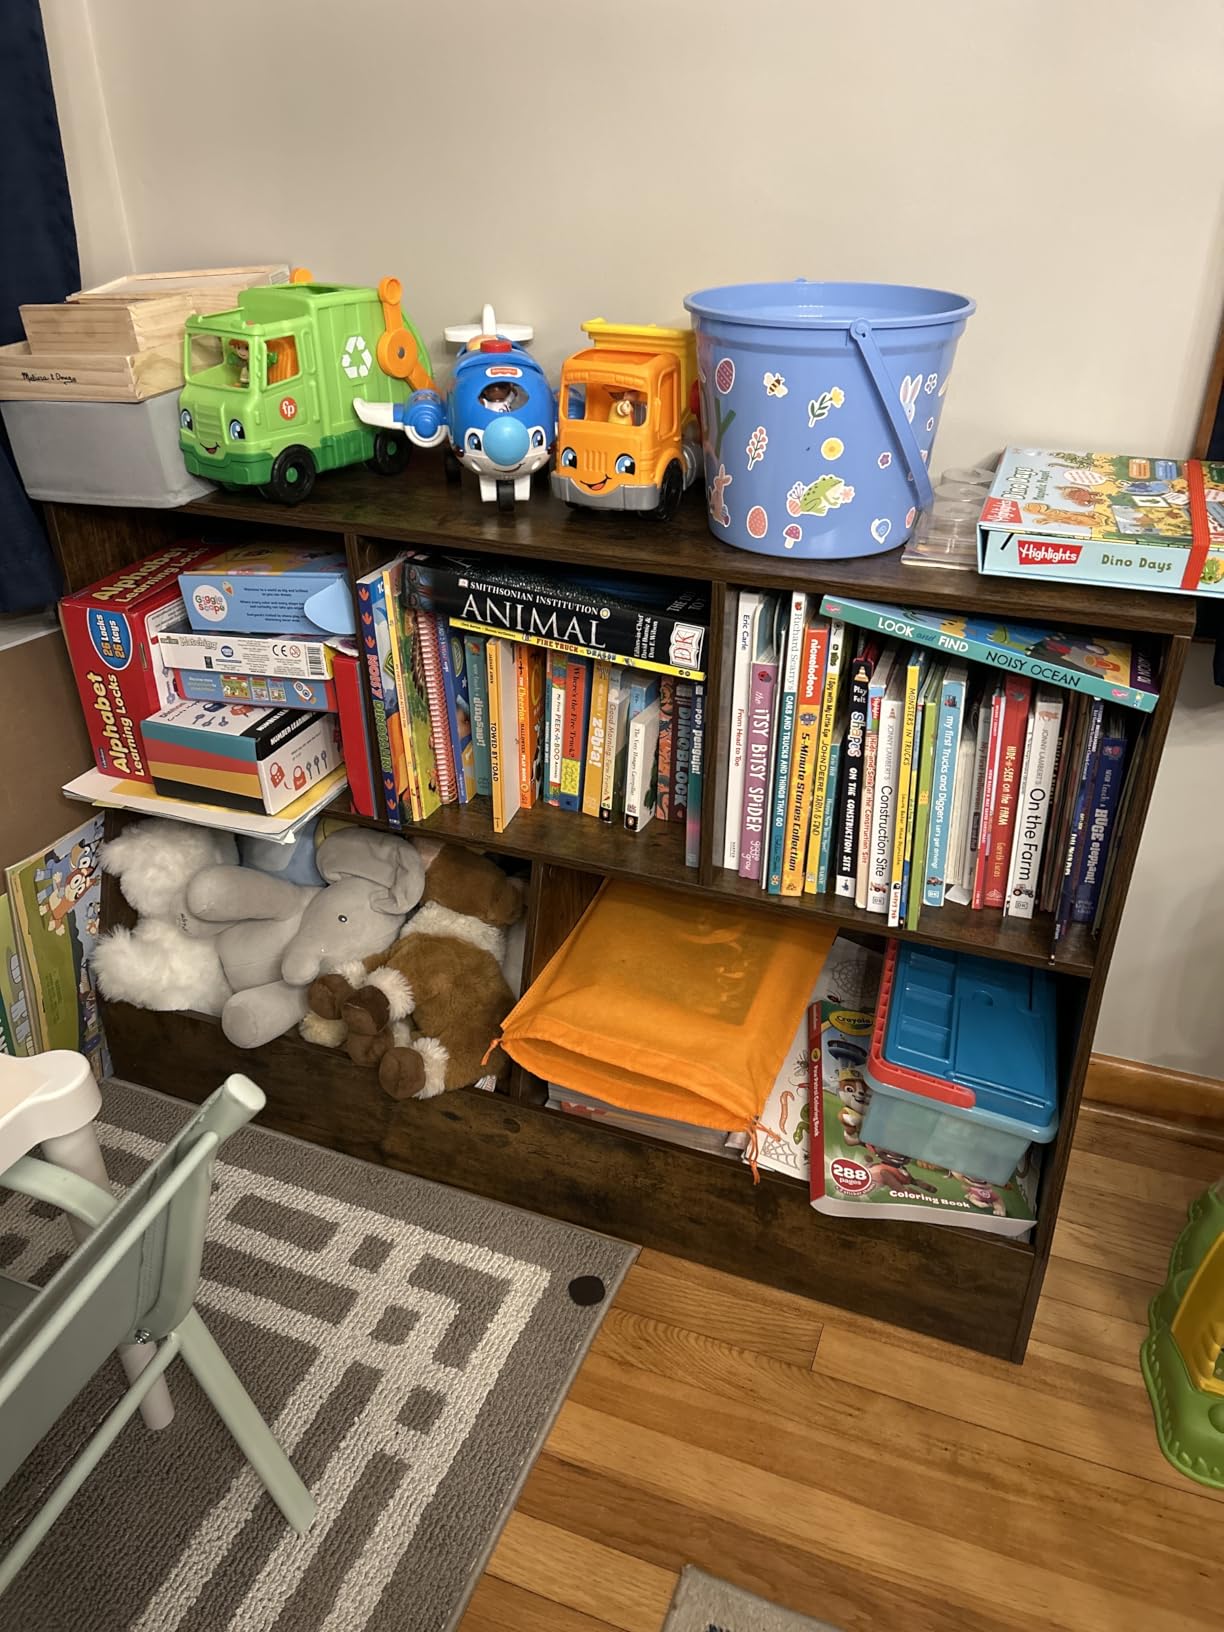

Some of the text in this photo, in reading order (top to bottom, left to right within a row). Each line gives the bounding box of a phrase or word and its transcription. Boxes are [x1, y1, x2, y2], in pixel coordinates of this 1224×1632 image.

[283, 401, 296, 416] fp
[1019, 544, 1078, 562] Highlights
[1102, 554, 1172, 572] Dino Days
[92, 548, 188, 600] Alphabet
[116, 566, 179, 602] Learning
[198, 604, 225, 614] Scope
[470, 581, 598, 616] SMITHSONIAN INSTITUTION
[96, 614, 112, 657] 26 Locks
[460, 593, 606, 648] ANIMAL
[110, 620, 126, 658] 26 Keys
[536, 637, 617, 661] FIRE TRUCK DRAGON
[672, 631, 696, 664] DK
[740, 630, 748, 650] Carle
[785, 612, 802, 690] Richard Scarry's
[878, 617, 1081, 688] LOOK and FIND NOISY OCEAN
[804, 638, 820, 698] nickelodeon
[753, 691, 764, 704] the
[825, 691, 833, 703] with
[826, 680, 834, 690] Spy
[854, 686, 868, 696] Play
[365, 652, 395, 774] NOISY DINOSAURS
[516, 686, 526, 720] Cheerios
[566, 666, 582, 758] Where's the Fire Truck?
[736, 708, 744, 727] From
[784, 695, 793, 714] CARS
[825, 704, 832, 713] My
[905, 687, 915, 726] MONSTERS
[86, 672, 130, 774] Alphabet
[108, 674, 144, 776] Learning Locks
[471, 695, 488, 746] dinosaur!
[783, 715, 791, 730] AND
[824, 713, 832, 727] Little
[904, 728, 912, 737] IN
[489, 722, 499, 781] TOWED BY TOAD
[552, 713, 561, 760] PEEK-A-BOO
[588, 716, 605, 767] zebra!
[690, 729, 702, 774] penguin!
[780, 731, 790, 759] TRUCKS
[819, 739, 827, 763] JOHN
[883, 723, 894, 780] JONNY LAMBERT'S
[979, 741, 987, 752] My
[673, 706, 691, 806] DINOBLOCK
[733, 755, 741, 766] Toe
[779, 759, 787, 774] AND
[902, 739, 911, 766] TRUCKS
[1034, 728, 1049, 785] JONNY LAMBERT'S
[816, 764, 824, 792] DEERE
[934, 715, 953, 823] my first Trucks and Diggers
[777, 775, 786, 798] THINGS
[787, 732, 811, 871] 5-Minute Stories Collection
[860, 737, 877, 864] Hide-and-Seek at the Construction Site
[974, 772, 984, 810] Halloween
[1000, 793, 1010, 804] the
[1001, 783, 1011, 793] on
[774, 817, 783, 827] GO
[775, 799, 784, 816] THAT
[840, 767, 858, 871] ON THE CONSTRUCTION SITE
[998, 806, 1009, 826] FARM
[874, 785, 892, 877] Construction Site
[1018, 787, 1046, 881] On the Farm
[1089, 807, 1110, 842] HUGE
[933, 837, 941, 847] get
[930, 847, 940, 868] driving!
[992, 841, 1005, 877] Gareth Lucas
[1083, 840, 1101, 884] elephant!
[833, 1164, 867, 1180] 288
[839, 1178, 862, 1186] pages
[889, 1190, 970, 1208] Coloring Book
